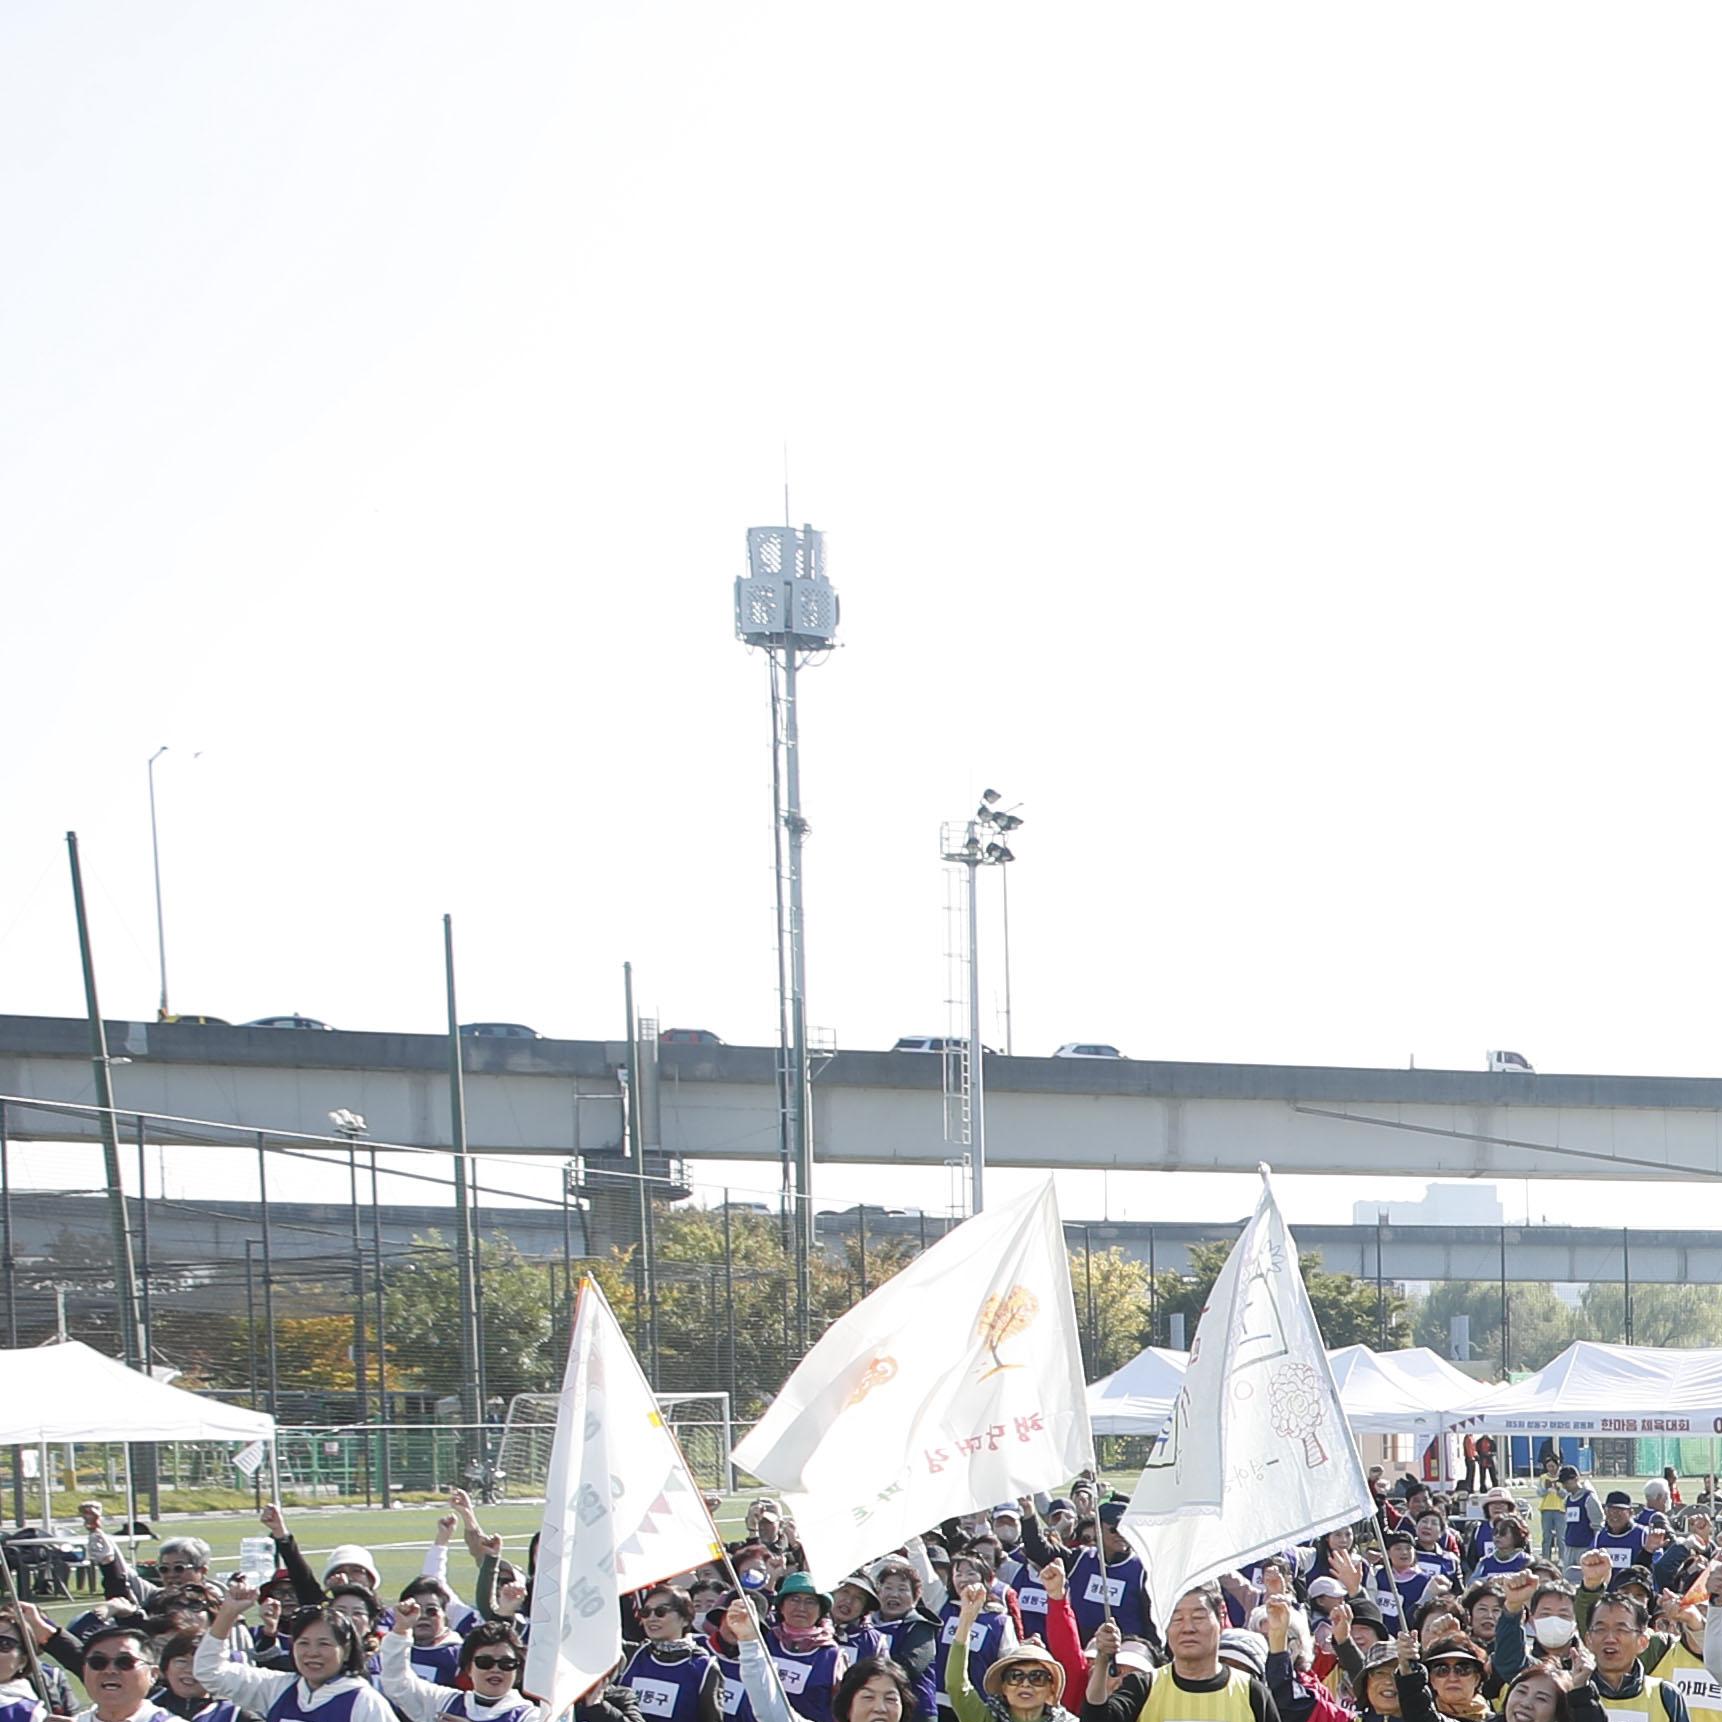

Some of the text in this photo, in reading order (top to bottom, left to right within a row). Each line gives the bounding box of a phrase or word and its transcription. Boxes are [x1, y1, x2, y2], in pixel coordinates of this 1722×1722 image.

[1601, 1418, 1637, 1432] 한마음
[1640, 1418, 1690, 1432] 체육대회
[948, 1624, 979, 1643] 성구
[778, 1668, 801, 1684] 동구
[1677, 1680, 1722, 1699] 아파트
